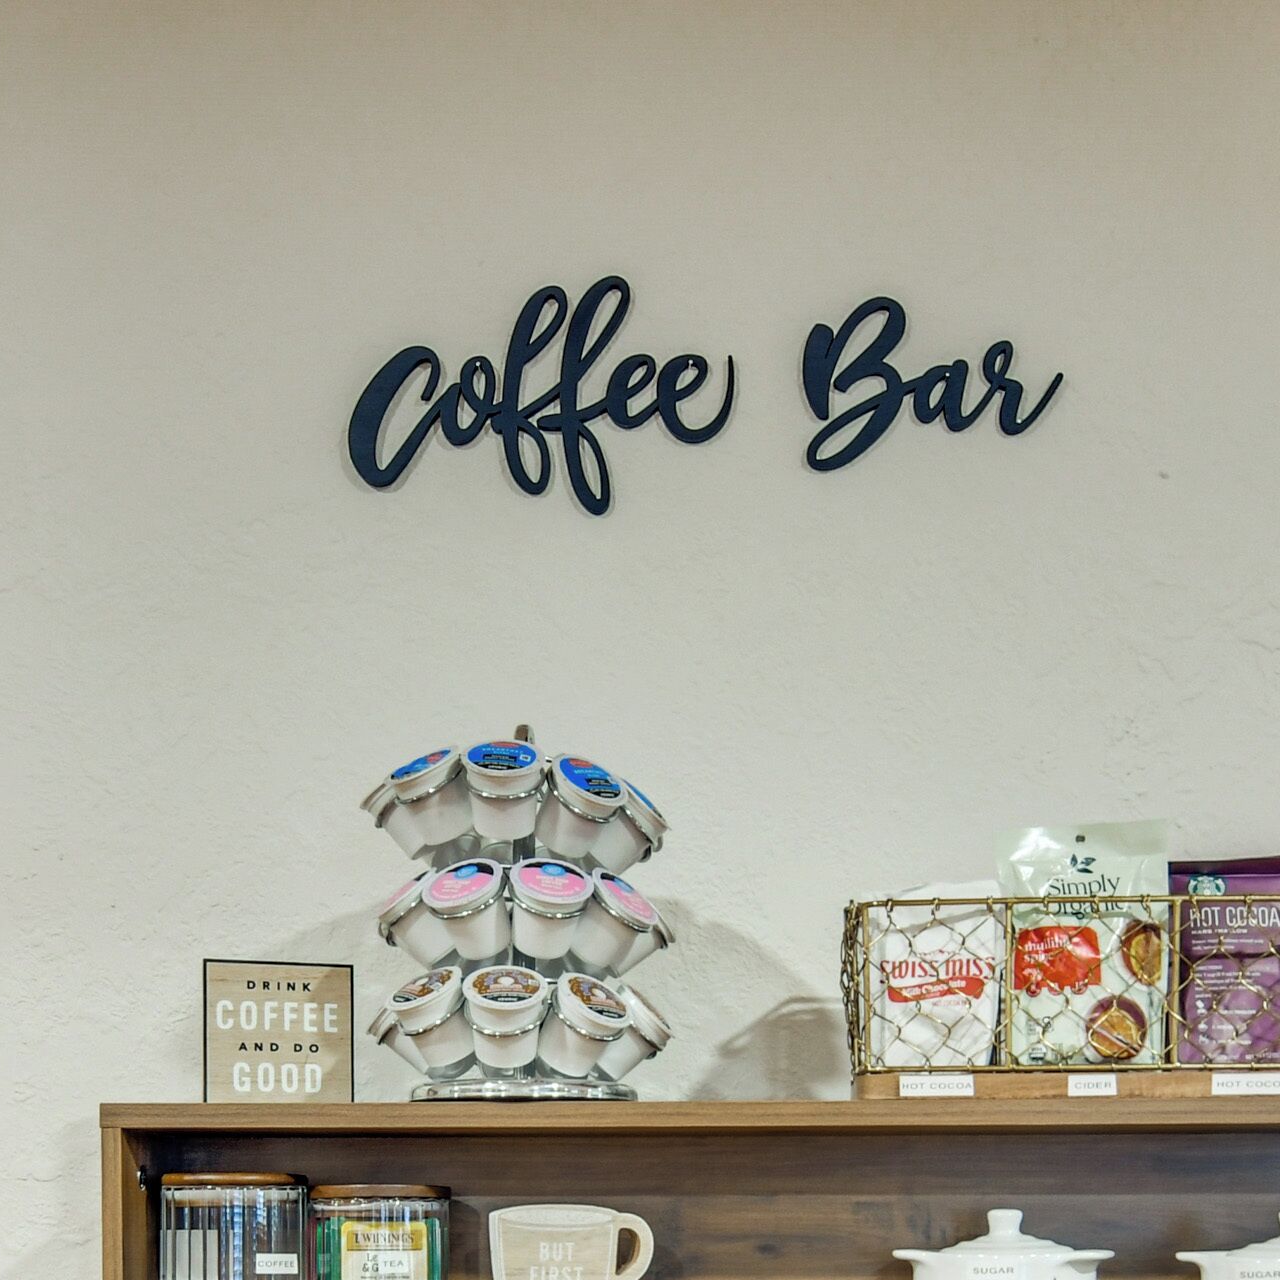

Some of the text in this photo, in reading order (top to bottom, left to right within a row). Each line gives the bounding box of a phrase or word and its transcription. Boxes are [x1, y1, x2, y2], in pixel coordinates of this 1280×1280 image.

[348, 276, 1063, 515] Coffee Bar
[1047, 874, 1121, 898] Simply
[945, 955, 996, 980] MISS
[246, 980, 312, 992] DRINK
[216, 999, 338, 1033] COFFEE
[238, 1042, 319, 1053] AND DO
[232, 1061, 323, 1093] GOOD
[902, 1082, 973, 1090] HOT COCOA
[1216, 1080, 1241, 1088] HOT
[539, 1242, 576, 1261] BUT
[257, 1260, 296, 1268] COFFEE
[382, 1260, 404, 1268] TEA
[973, 1266, 1015, 1274] SUGAR
